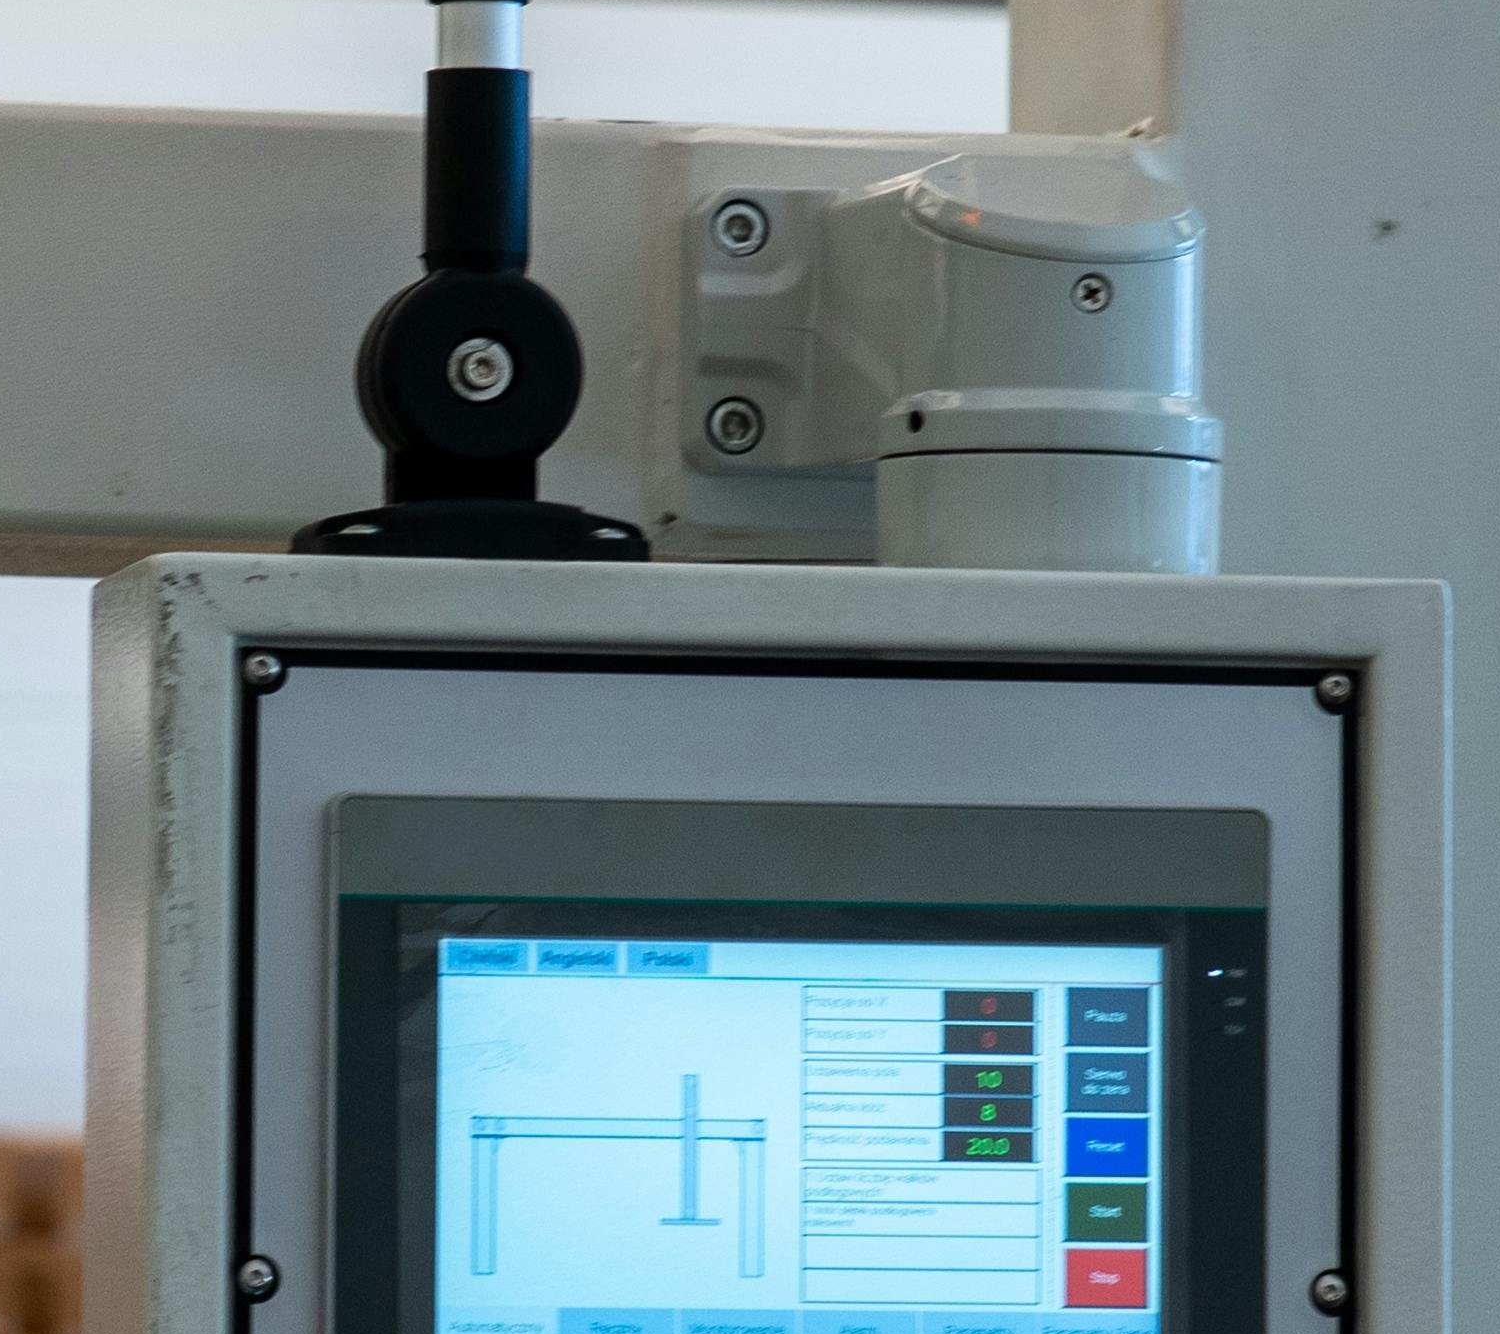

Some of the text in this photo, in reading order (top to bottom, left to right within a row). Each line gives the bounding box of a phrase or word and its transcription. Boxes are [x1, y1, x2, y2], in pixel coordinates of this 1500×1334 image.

[642, 950, 695, 967] Polski
[1083, 1008, 1128, 1023] Pauza
[975, 1069, 1004, 1089] 10
[979, 1103, 998, 1122] 8
[1087, 1204, 1123, 1218] Start
[1087, 1270, 1121, 1285] Stop
